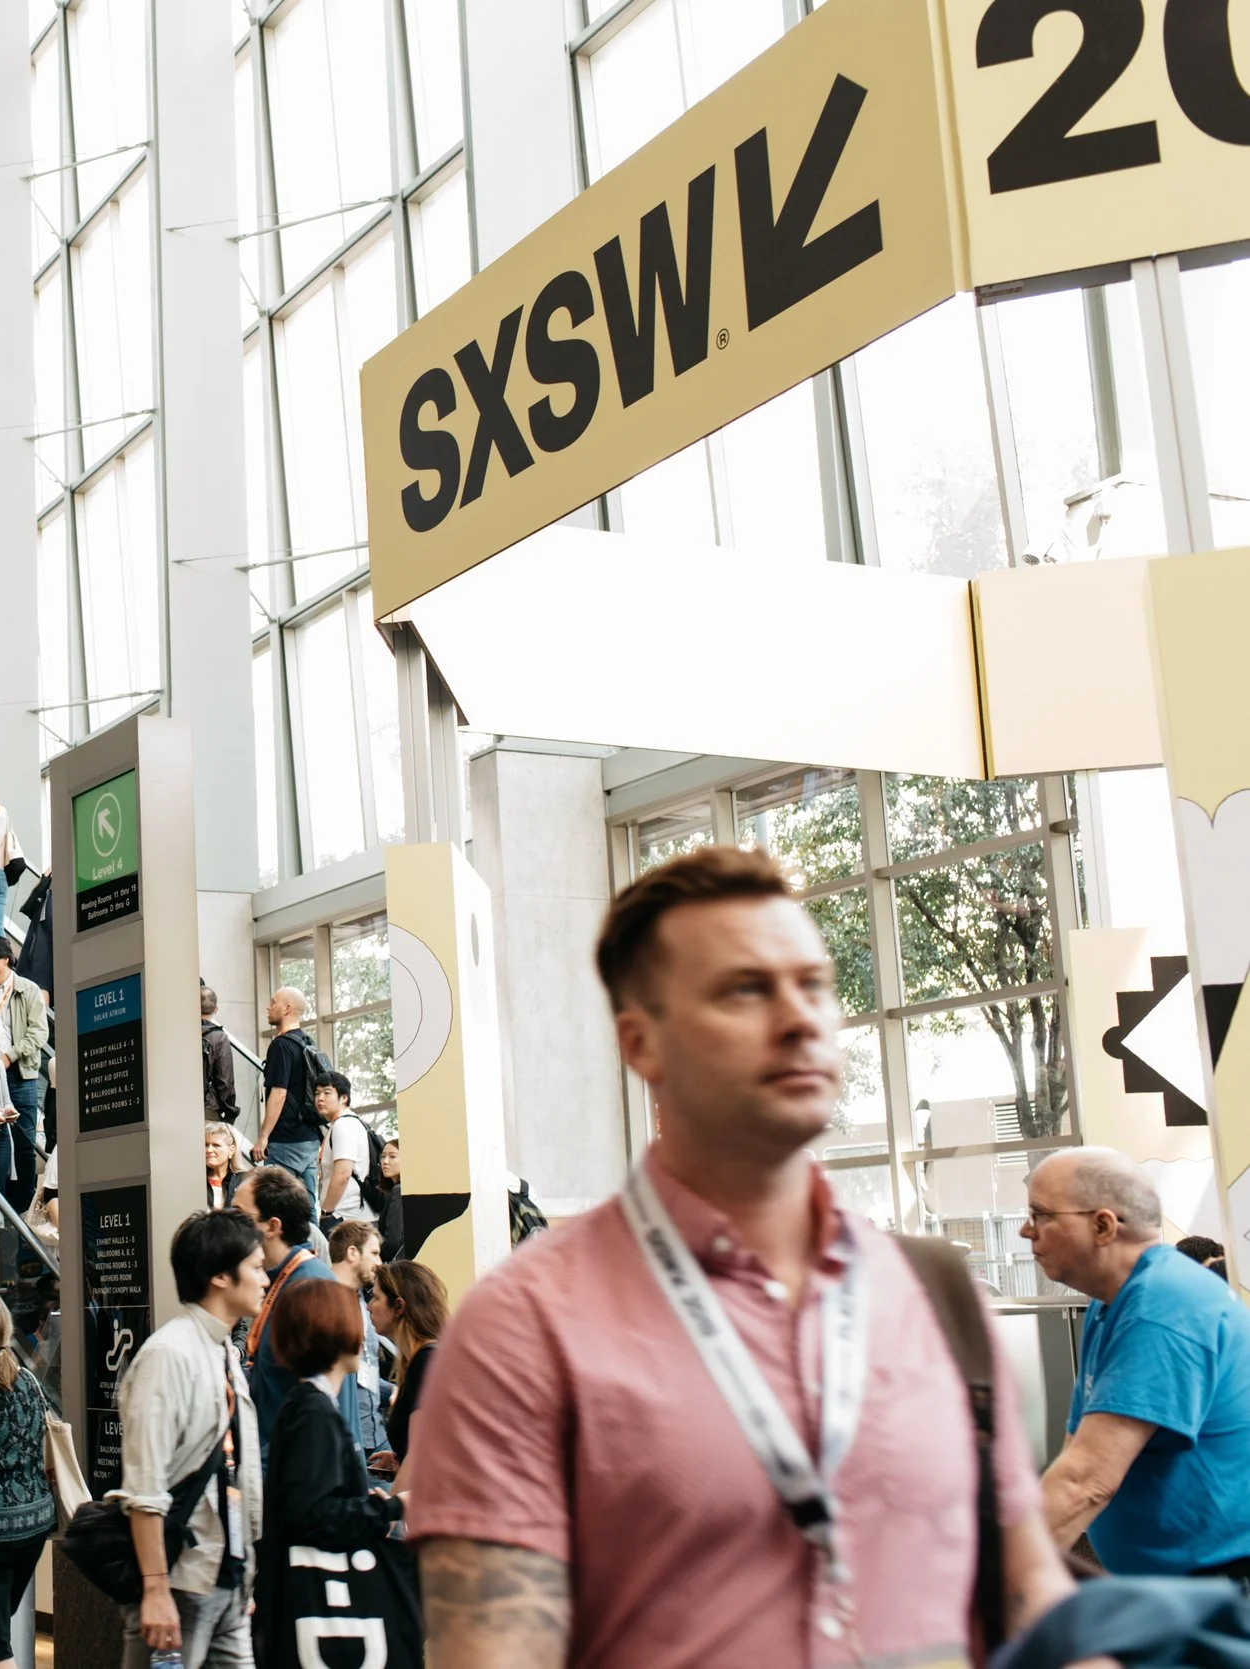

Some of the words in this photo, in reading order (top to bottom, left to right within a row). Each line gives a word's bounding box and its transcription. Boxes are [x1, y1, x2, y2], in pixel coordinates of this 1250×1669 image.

[400, 163, 716, 533] SXSW
[92, 859, 115, 881] Level
[117, 857, 123, 870] 4
[97, 894, 112, 904] Rooms
[120, 888, 130, 897] thru
[88, 908, 109, 920] Ballrooms
[110, 904, 114, 912] D
[115, 902, 125, 910] thru
[94, 990, 117, 1008] LEVEL
[119, 988, 125, 1001] 1
[93, 1011, 108, 1022] SOLAR
[109, 1007, 126, 1018] ATRIUM
[90, 1046, 107, 1057] EXHIBIT
[108, 1042, 123, 1052] HALLS
[90, 1060, 107, 1071] EXHIBIT
[108, 1056, 123, 1066] HALLS
[91, 1075, 103, 1085] FIRST
[104, 1073, 112, 1081] AID
[113, 1069, 129, 1080] OFFICE
[91, 1087, 118, 1099] BALLROOMS
[130, 1083, 134, 1091] C
[91, 1103, 111, 1113] MEETING
[111, 1099, 128, 1109] ROOMS
[100, 1214, 123, 1229] LEVEL
[125, 1213, 131, 1226] 1
[96, 1237, 111, 1246] EXHIBIT
[112, 1237, 125, 1245] HALLS
[97, 1249, 121, 1258] BALLROOMS
[95, 1262, 112, 1271] MEETING
[112, 1261, 127, 1269] ROOMS
[100, 1274, 119, 1282] MOTHERS
[112, 1286, 129, 1294] CANOPY
[104, 1421, 123, 1436] LEVE
[100, 1445, 122, 1454] BALLROOM
